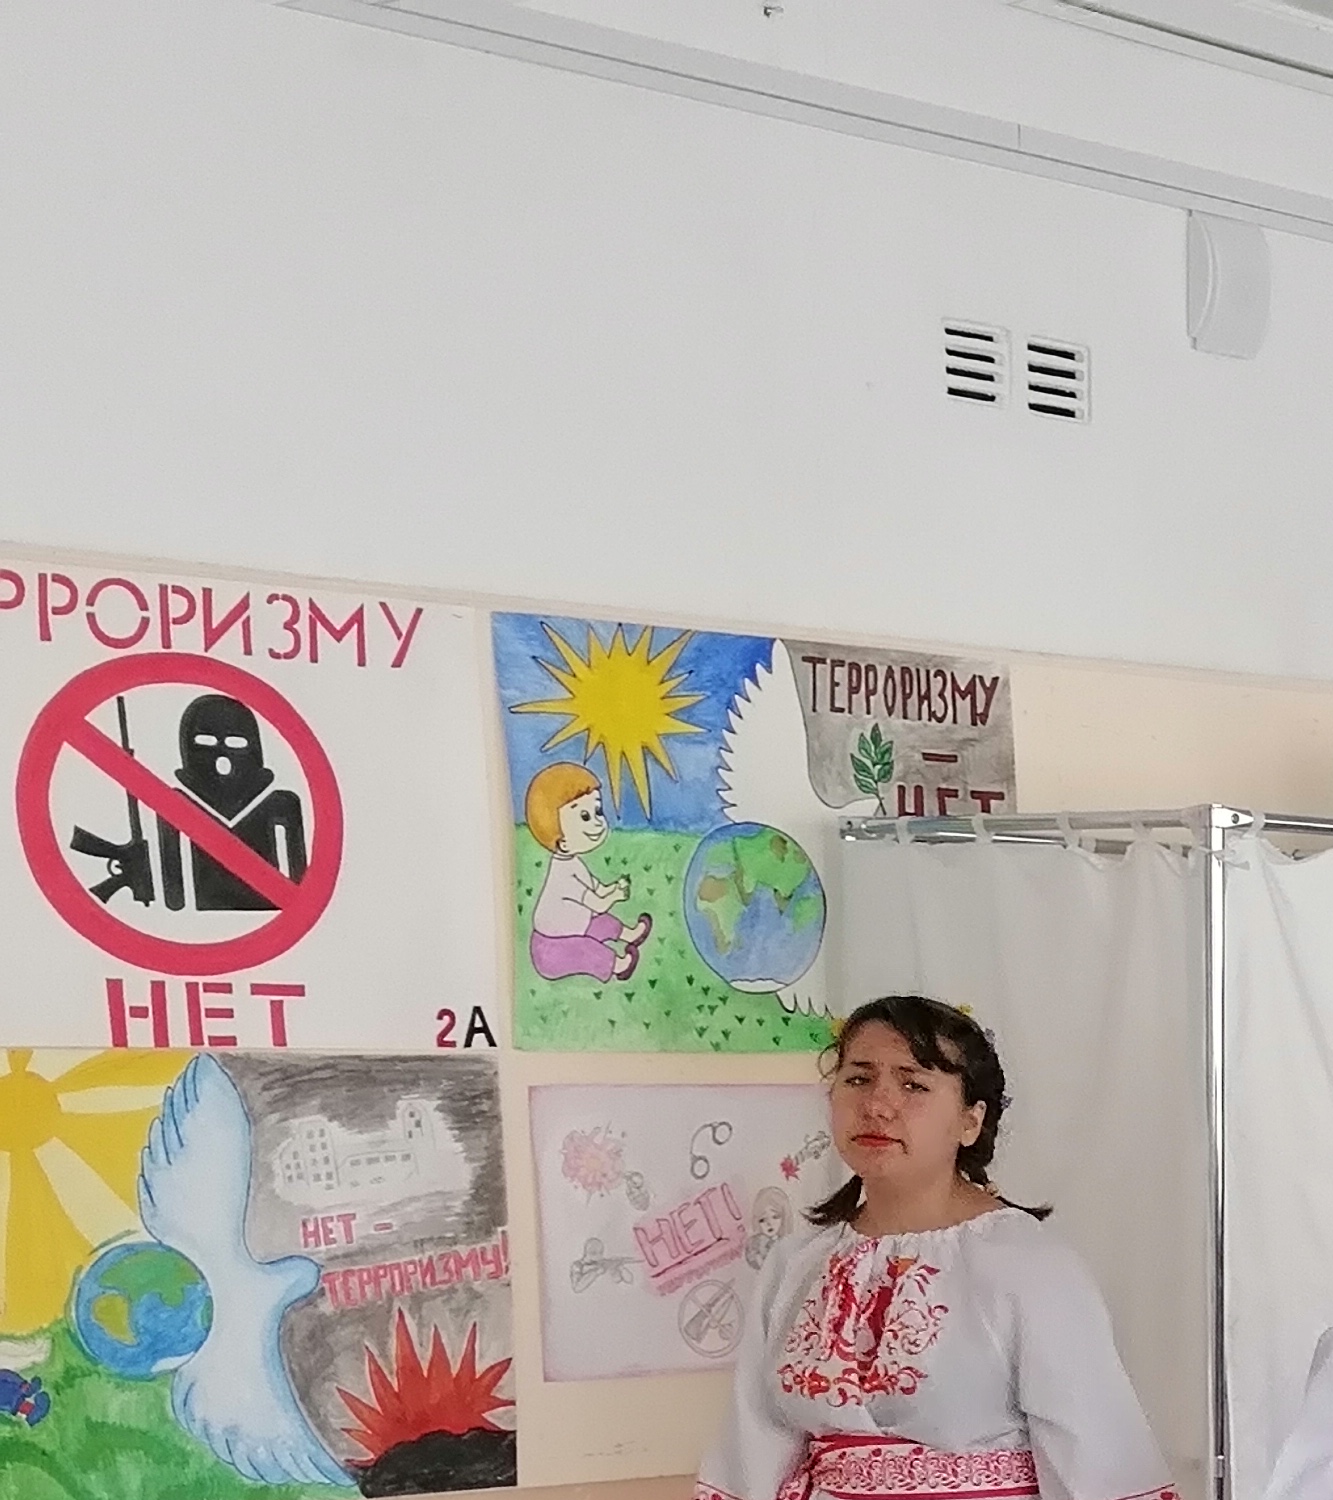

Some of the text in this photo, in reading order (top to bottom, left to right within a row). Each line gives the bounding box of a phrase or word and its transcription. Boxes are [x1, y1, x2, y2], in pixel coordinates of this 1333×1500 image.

[801, 655, 1000, 727] ТЕРРОРИЗМУ
[105, 978, 306, 1048] НЕТ
[301, 1212, 357, 1249] НЕТ
[632, 1181, 746, 1269] НЕТ!
[321, 1229, 510, 1309] ТЕРРОРИЗМУ!
